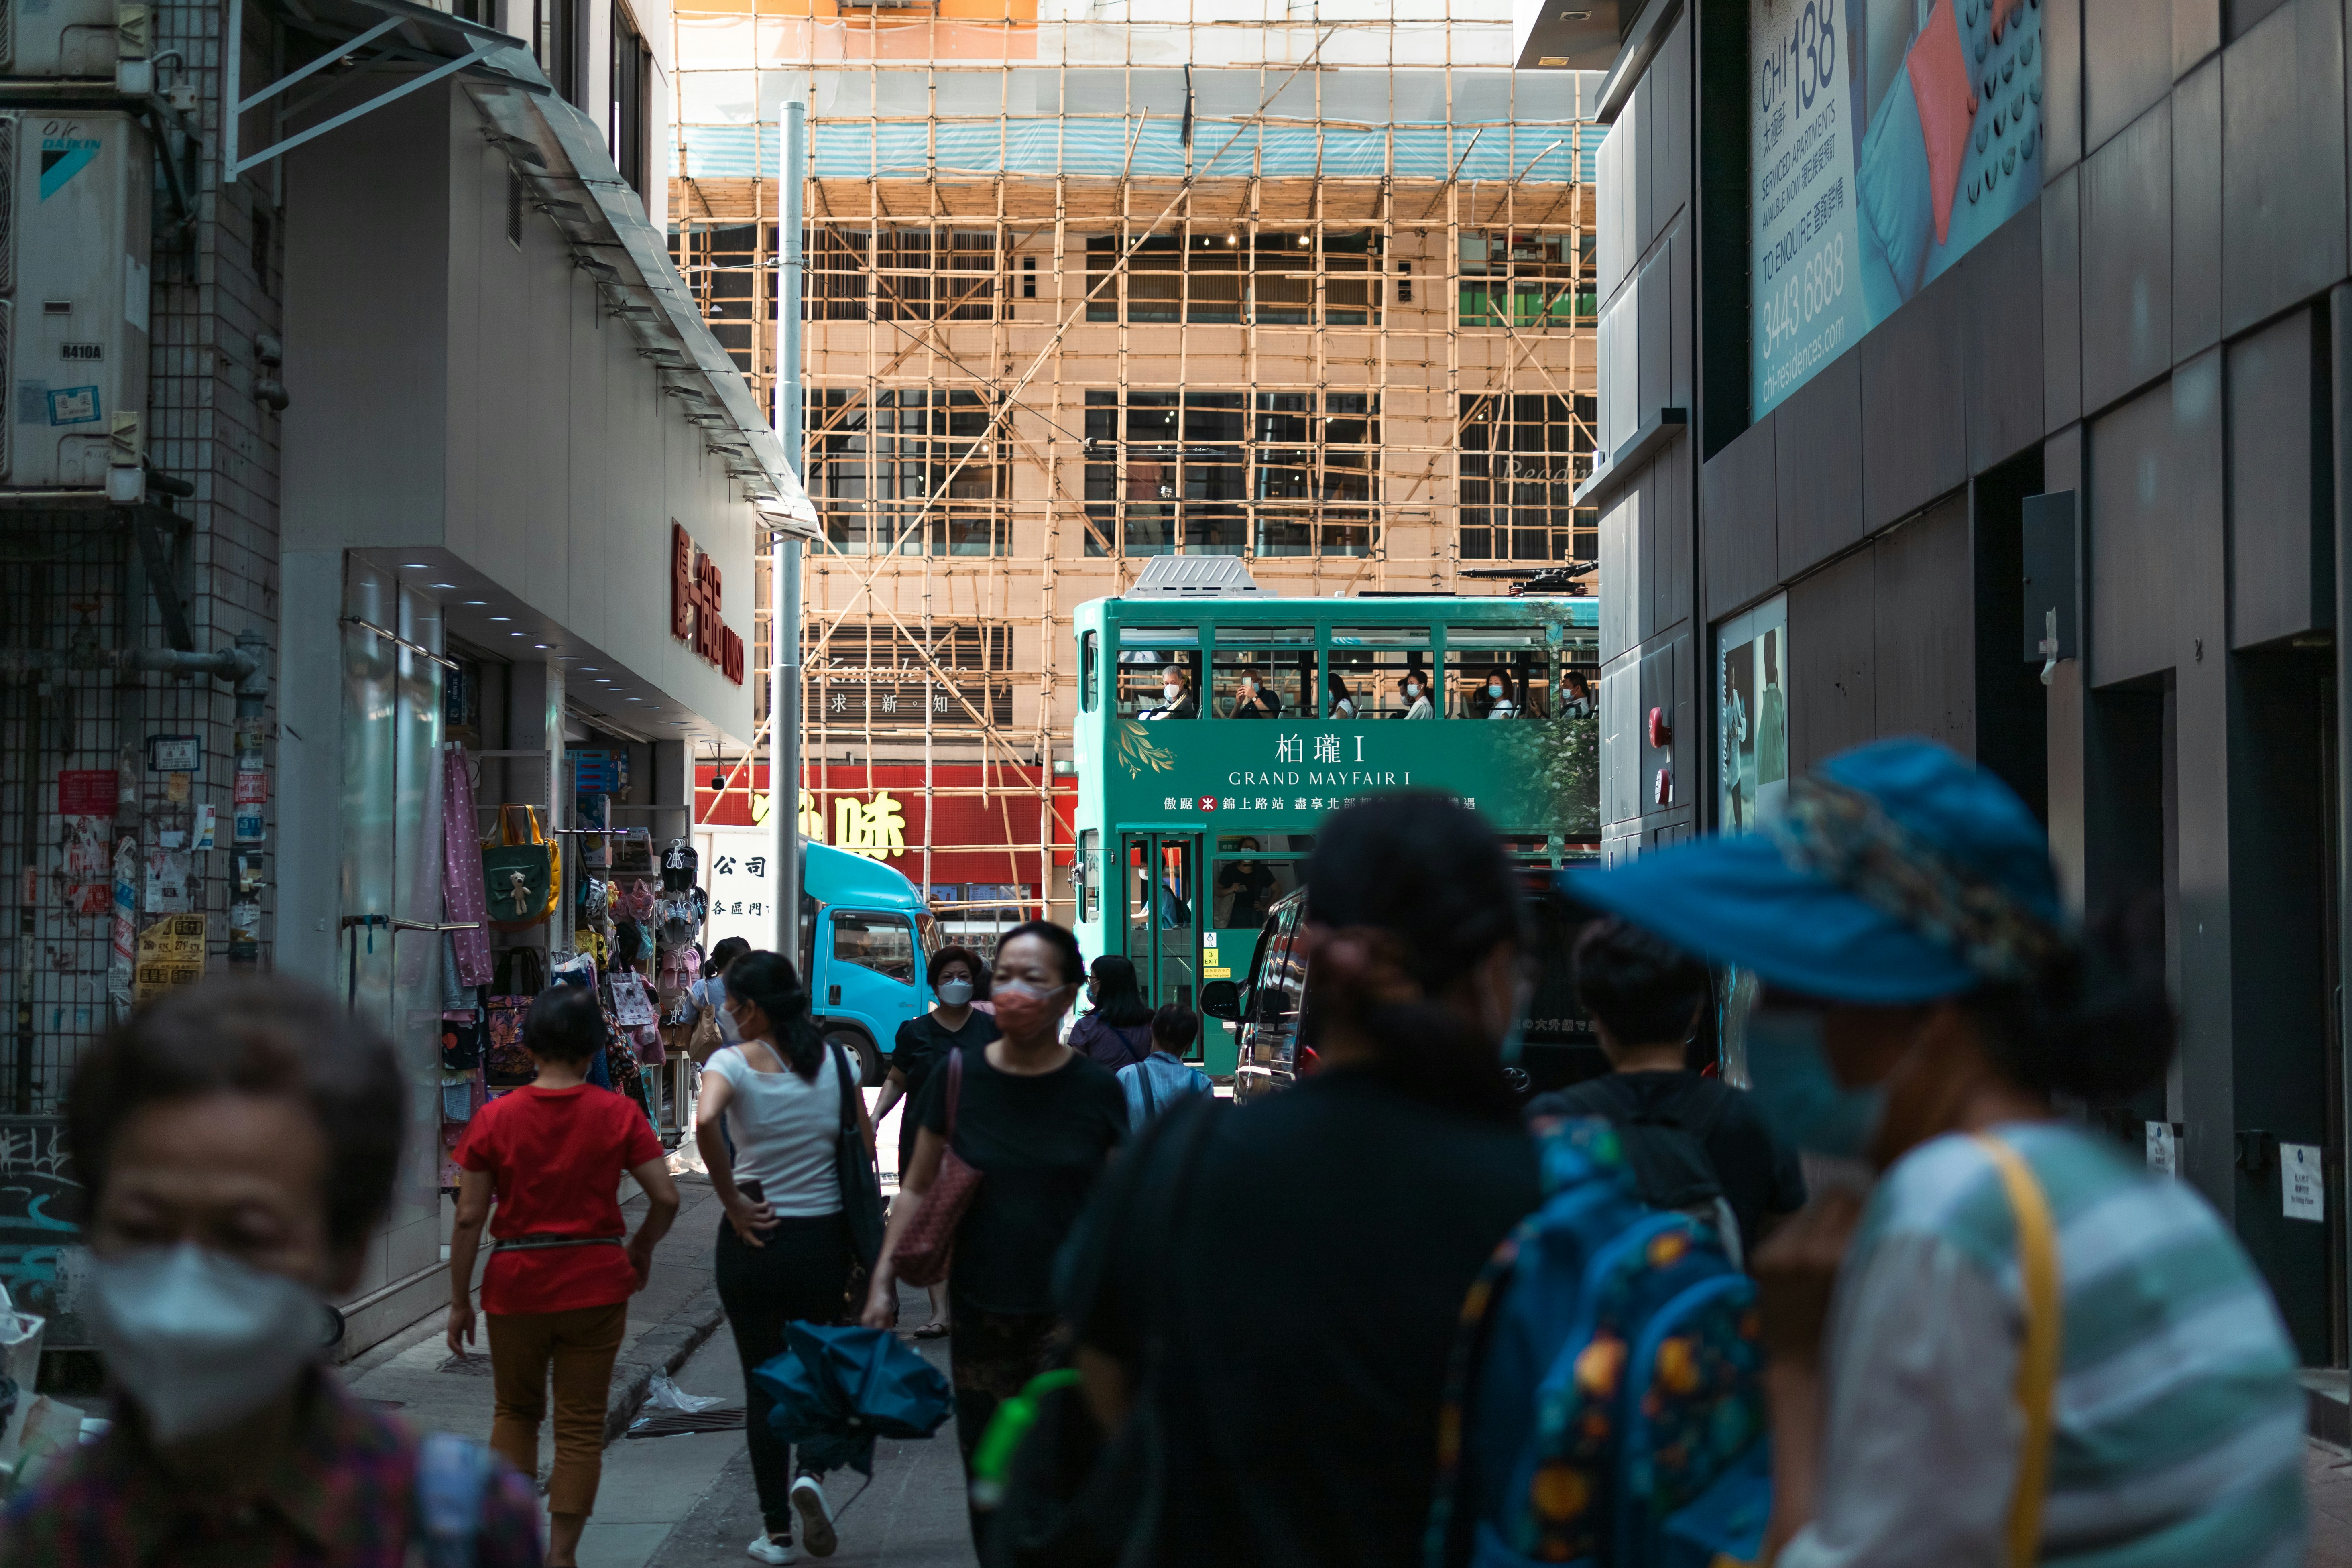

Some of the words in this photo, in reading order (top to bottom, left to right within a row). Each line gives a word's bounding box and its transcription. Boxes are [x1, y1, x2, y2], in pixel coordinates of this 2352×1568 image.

[1762, 37, 1786, 113] CHI
[1790, 0, 1835, 120] 138
[43, 139, 101, 149] DAIKIN
[1762, 151, 1790, 201] SERVICED
[1792, 99, 1835, 167] APARTMENTS
[1763, 101, 1786, 159] 太極軒
[1762, 191, 1785, 232] AVAILBLE
[1786, 173, 1800, 205] NOW
[1801, 133, 1835, 189] 現已接受預訂
[1763, 250, 1774, 284] TO
[1776, 210, 1811, 273] ENQUIRE
[1814, 177, 1843, 235] 查詢詳情
[1763, 275, 1799, 360] 3443
[1805, 232, 1843, 323] 6888
[63, 346, 101, 358] R410A
[1763, 316, 1844, 403] chi-residences.com
[1275, 733, 1341, 763] 柏瓏
[1229, 772, 1299, 785] GRAND
[1309, 772, 1397, 785] MAYFAIR
[1405, 772, 1410, 785] I
[1164, 797, 1192, 810] 傲踞
[1223, 797, 1284, 810] 錦上路站
[714, 856, 766, 878] 公司
[711, 900, 769, 916] 各區門
